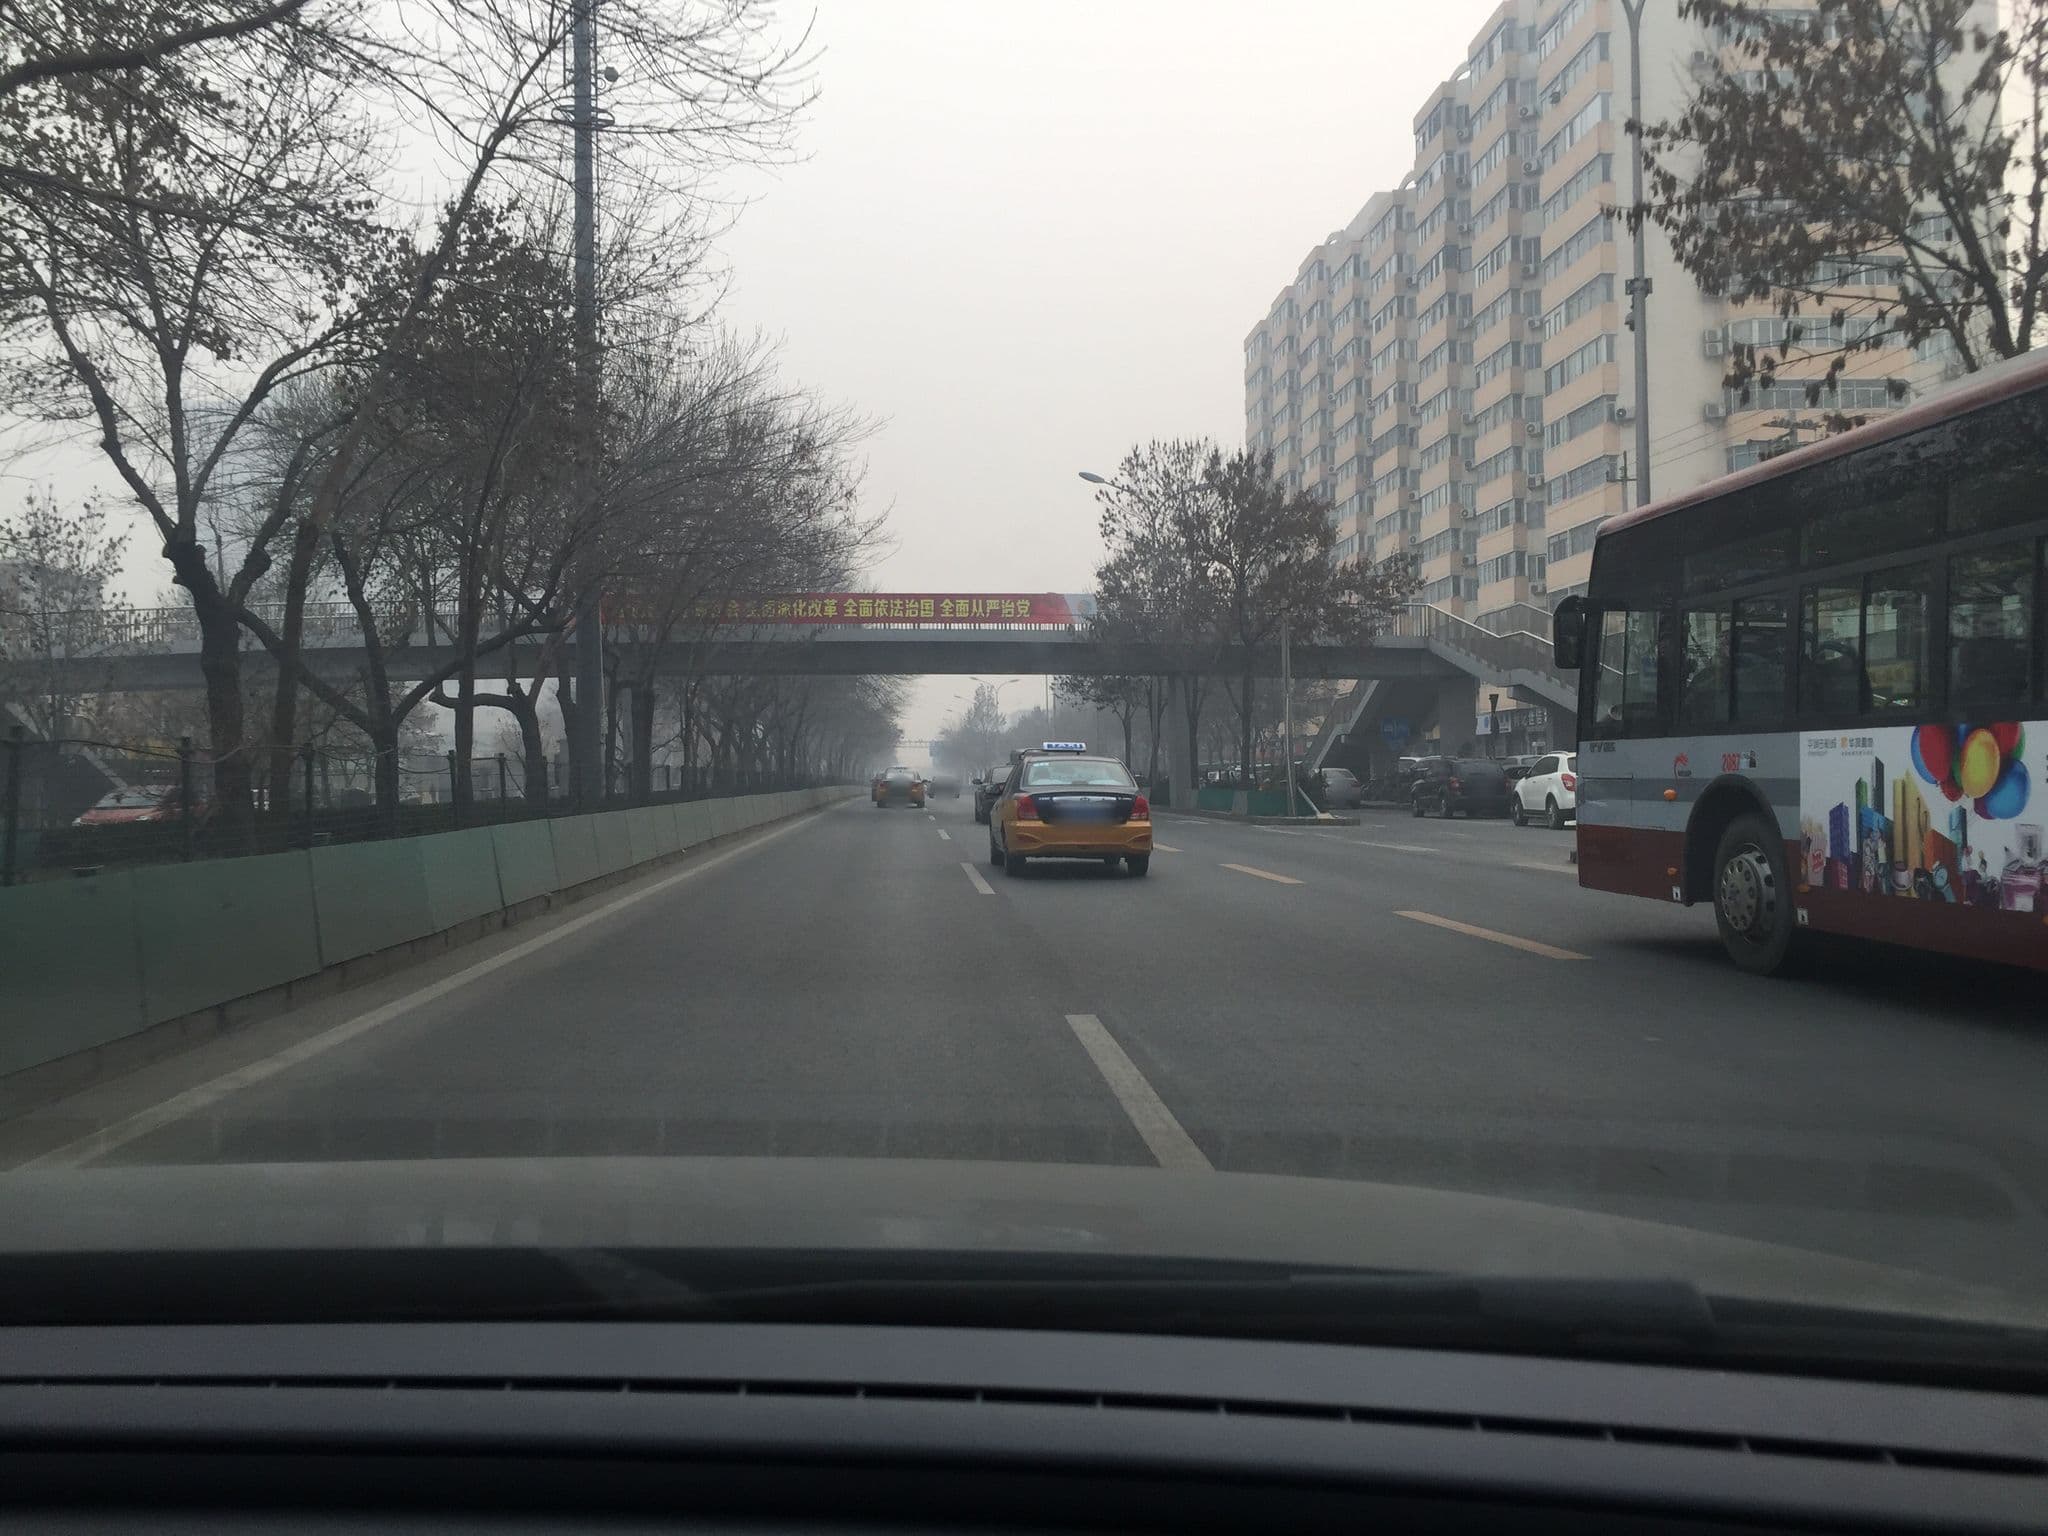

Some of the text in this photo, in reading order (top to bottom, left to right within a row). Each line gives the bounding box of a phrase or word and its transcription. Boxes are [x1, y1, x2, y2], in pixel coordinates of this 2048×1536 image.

[843, 598, 934, 618] 全面依法治国
[940, 598, 1031, 618] 全面从严治党
